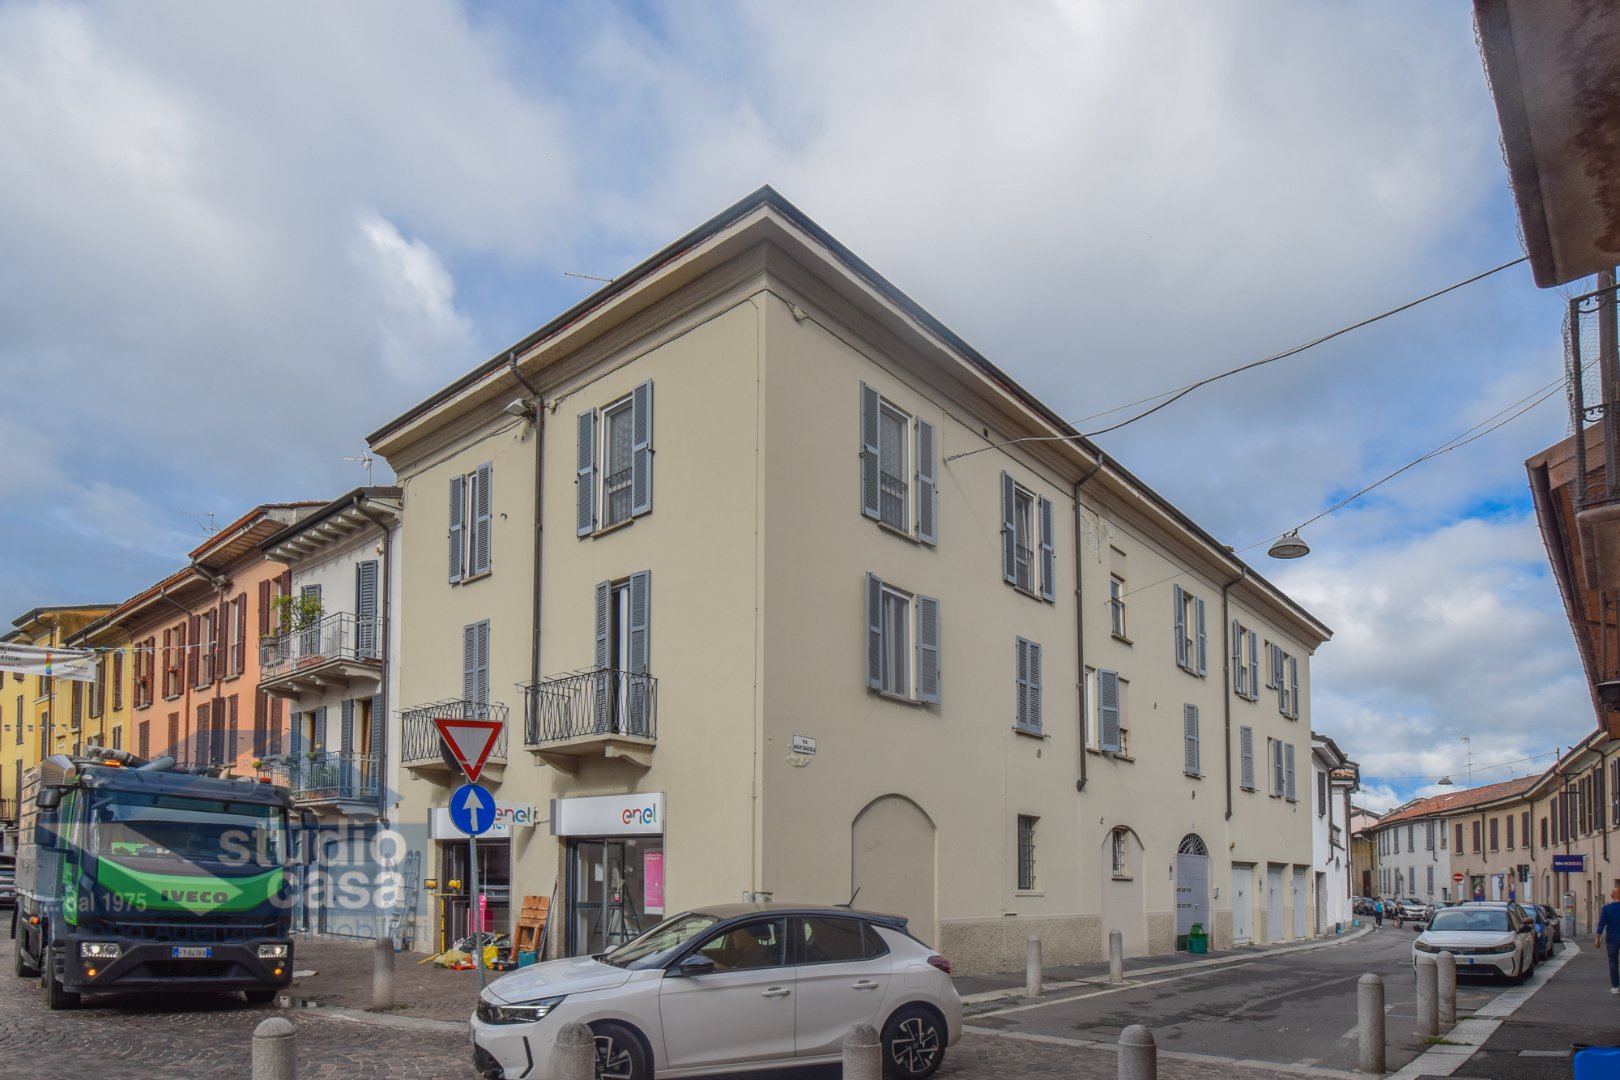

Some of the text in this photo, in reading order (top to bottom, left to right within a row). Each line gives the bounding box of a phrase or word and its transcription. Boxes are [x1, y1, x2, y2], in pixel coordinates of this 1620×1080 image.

[494, 806, 531, 823] enel
[621, 803, 656, 825] enel
[160, 889, 229, 904] IVECO
